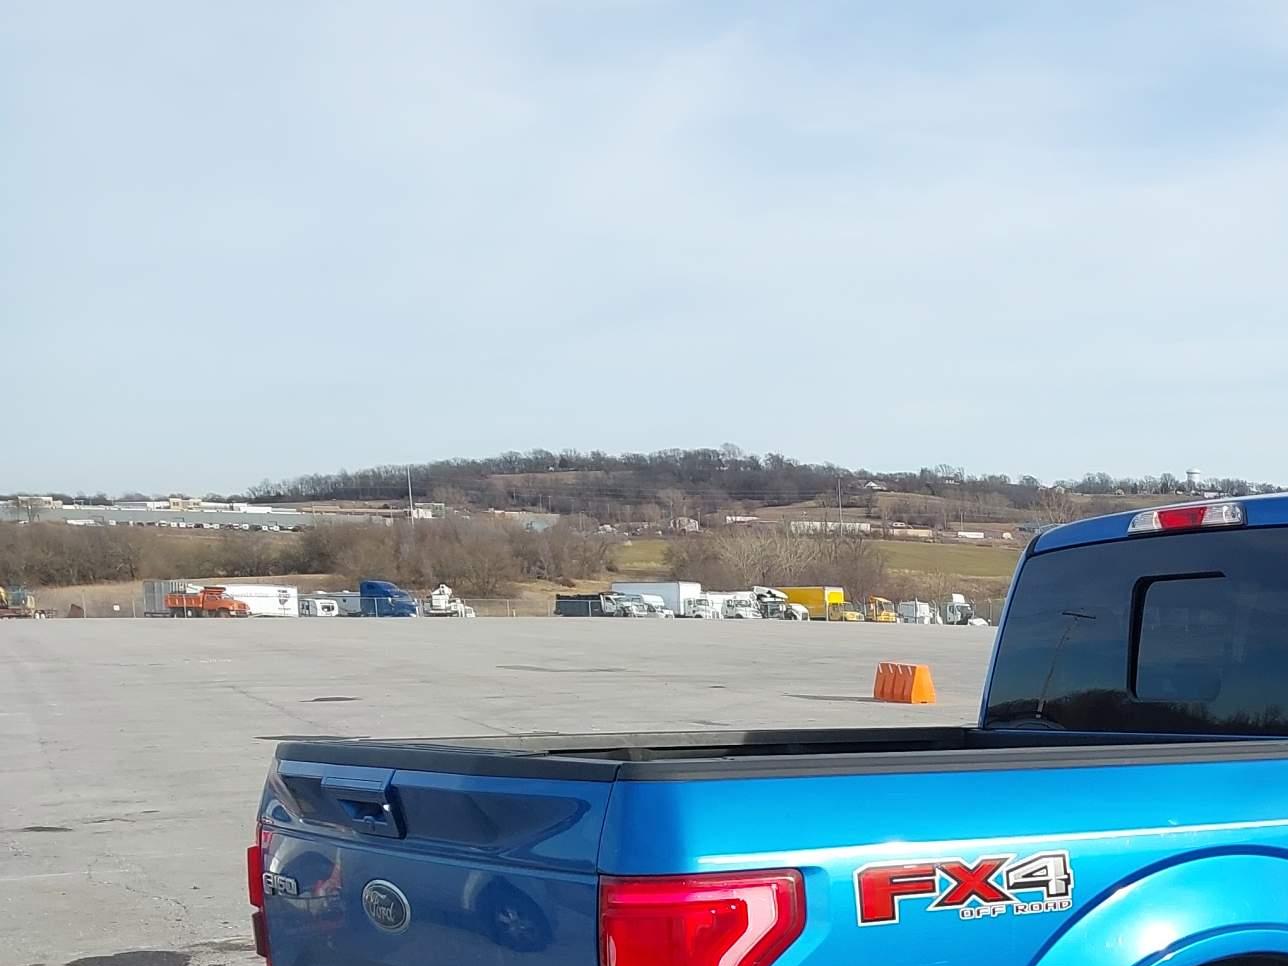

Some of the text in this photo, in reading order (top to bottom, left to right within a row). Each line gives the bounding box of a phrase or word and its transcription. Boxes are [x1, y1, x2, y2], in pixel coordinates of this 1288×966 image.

[857, 852, 1072, 924] FX4
[960, 899, 1072, 919] OFF ROAD
